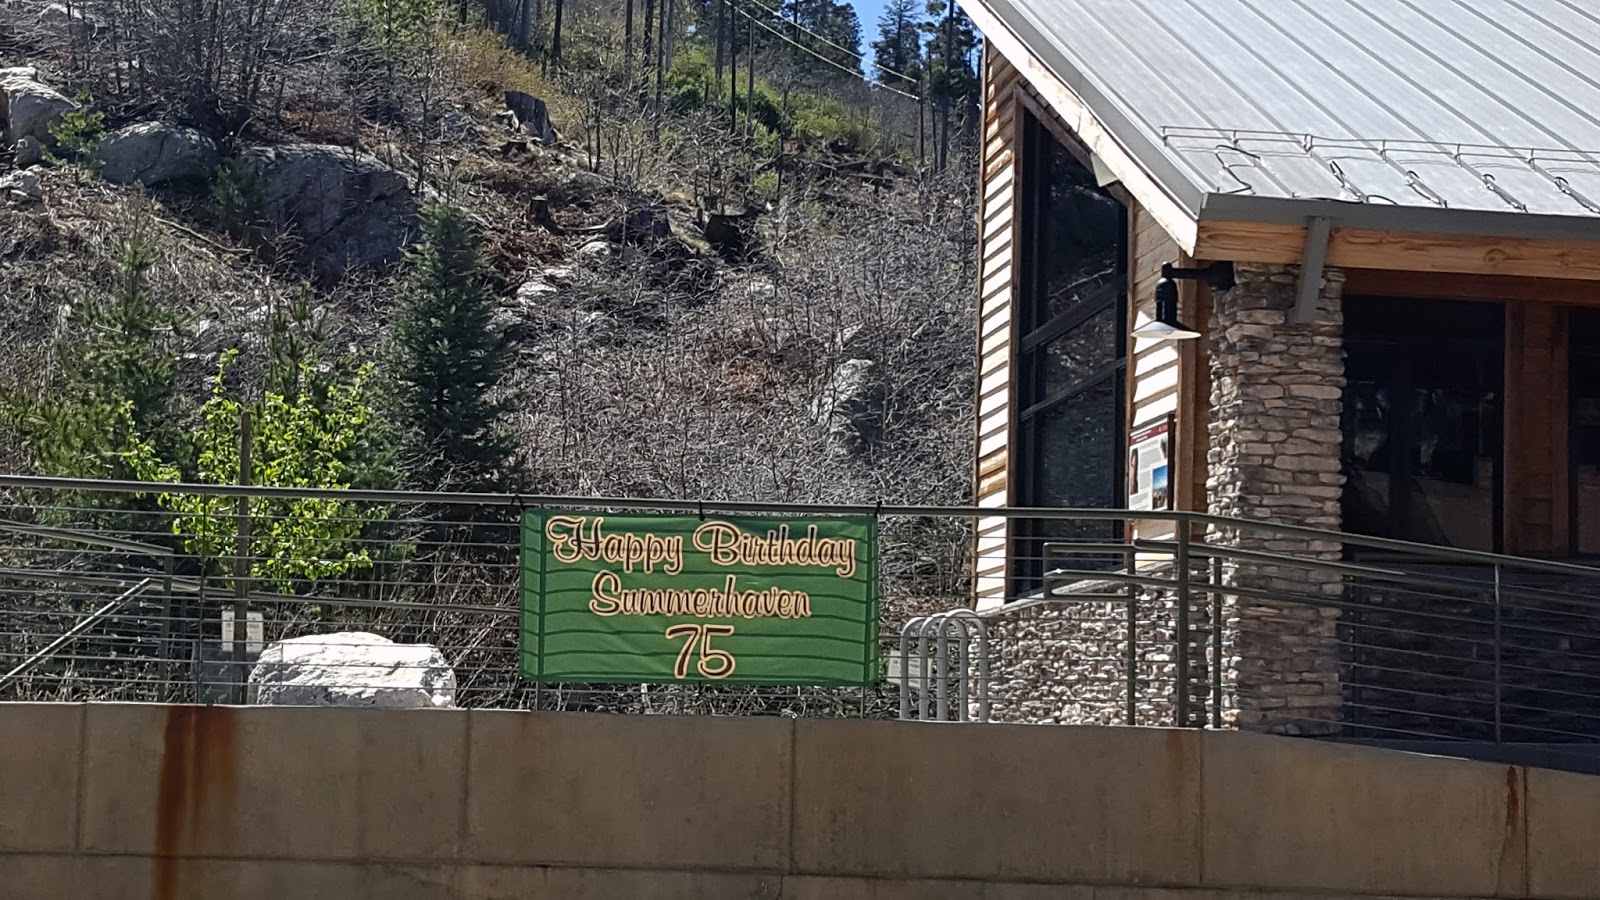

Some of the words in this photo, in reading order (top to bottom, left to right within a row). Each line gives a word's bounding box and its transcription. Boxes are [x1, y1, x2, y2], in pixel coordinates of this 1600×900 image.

[546, 515, 683, 574] Happy
[693, 520, 856, 577] Birthday
[590, 571, 811, 618] Summerhaven
[666, 624, 735, 679] 75
